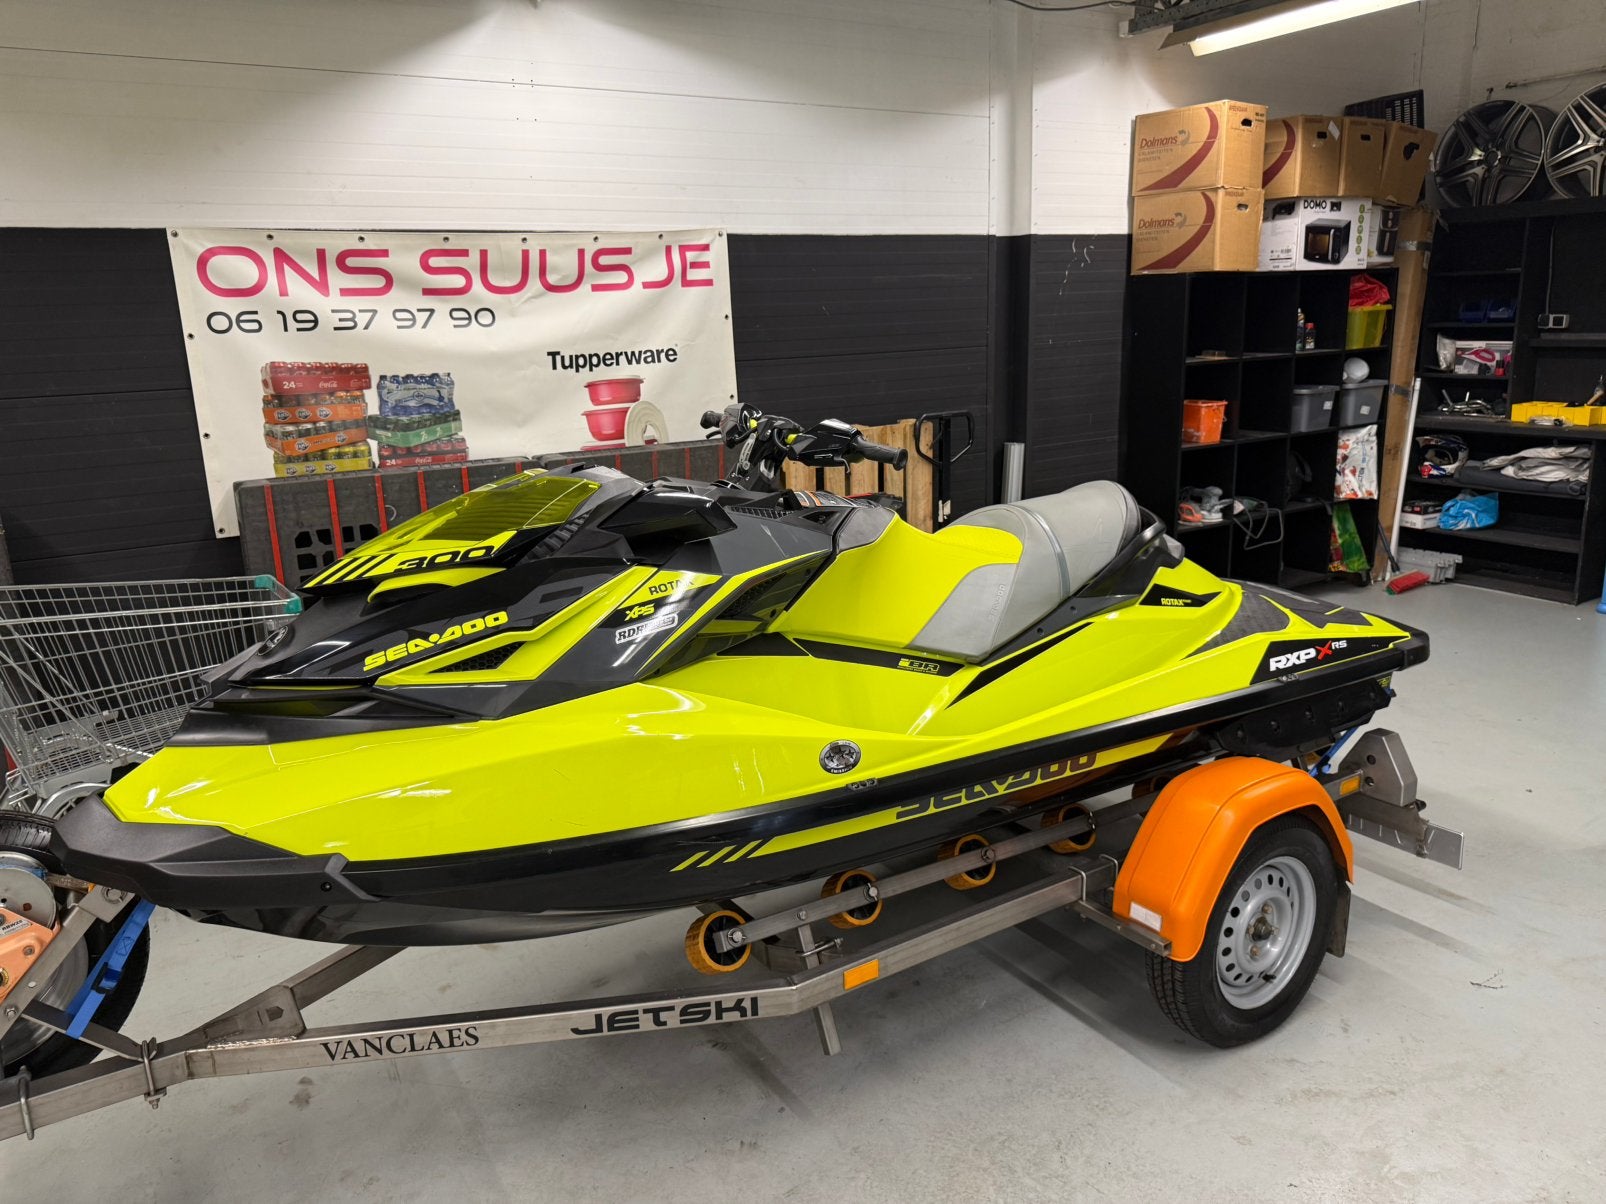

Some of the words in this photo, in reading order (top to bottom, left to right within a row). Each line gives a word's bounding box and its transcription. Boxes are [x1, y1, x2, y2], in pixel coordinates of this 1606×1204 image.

[1303, 199, 1327, 210] DOMO
[196, 245, 394, 298] ONS
[206, 310, 263, 334] 06
[276, 309, 319, 332] 19
[330, 308, 378, 331] 37
[392, 308, 436, 330] 97
[449, 307, 496, 329] 90
[546, 346, 678, 373] Tupperware
[282, 381, 296, 389] 24
[392, 545, 495, 573] 300
[624, 603, 655, 621] XPS
[1269, 647, 1317, 672] RXP
[1331, 639, 1348, 650] RS
[570, 996, 760, 1036] JETSKI
[319, 1026, 480, 1062] VANCLAES
